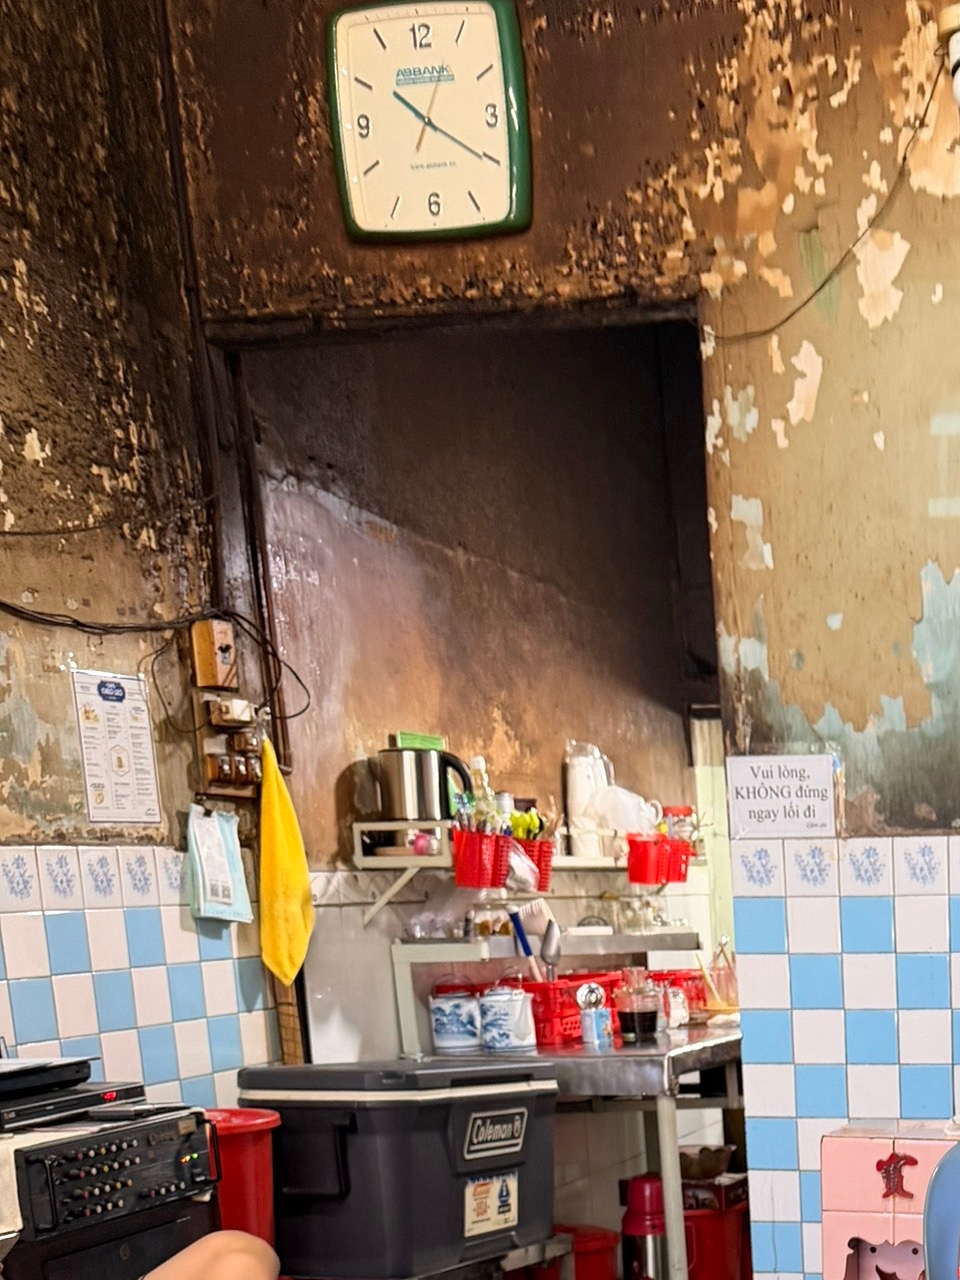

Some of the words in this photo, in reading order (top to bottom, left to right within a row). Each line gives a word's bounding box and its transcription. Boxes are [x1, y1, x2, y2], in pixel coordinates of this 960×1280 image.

[410, 23, 432, 49] 12
[396, 64, 450, 79] ABBANK
[357, 114, 370, 139] 9
[485, 103, 498, 128] 3
[428, 192, 441, 216] 6
[750, 765, 774, 779] Vui
[735, 782, 791, 800] KHÔNG
[748, 808, 779, 823] ngay
[803, 805, 816, 818] đi
[472, 1118, 514, 1144] Coleman
